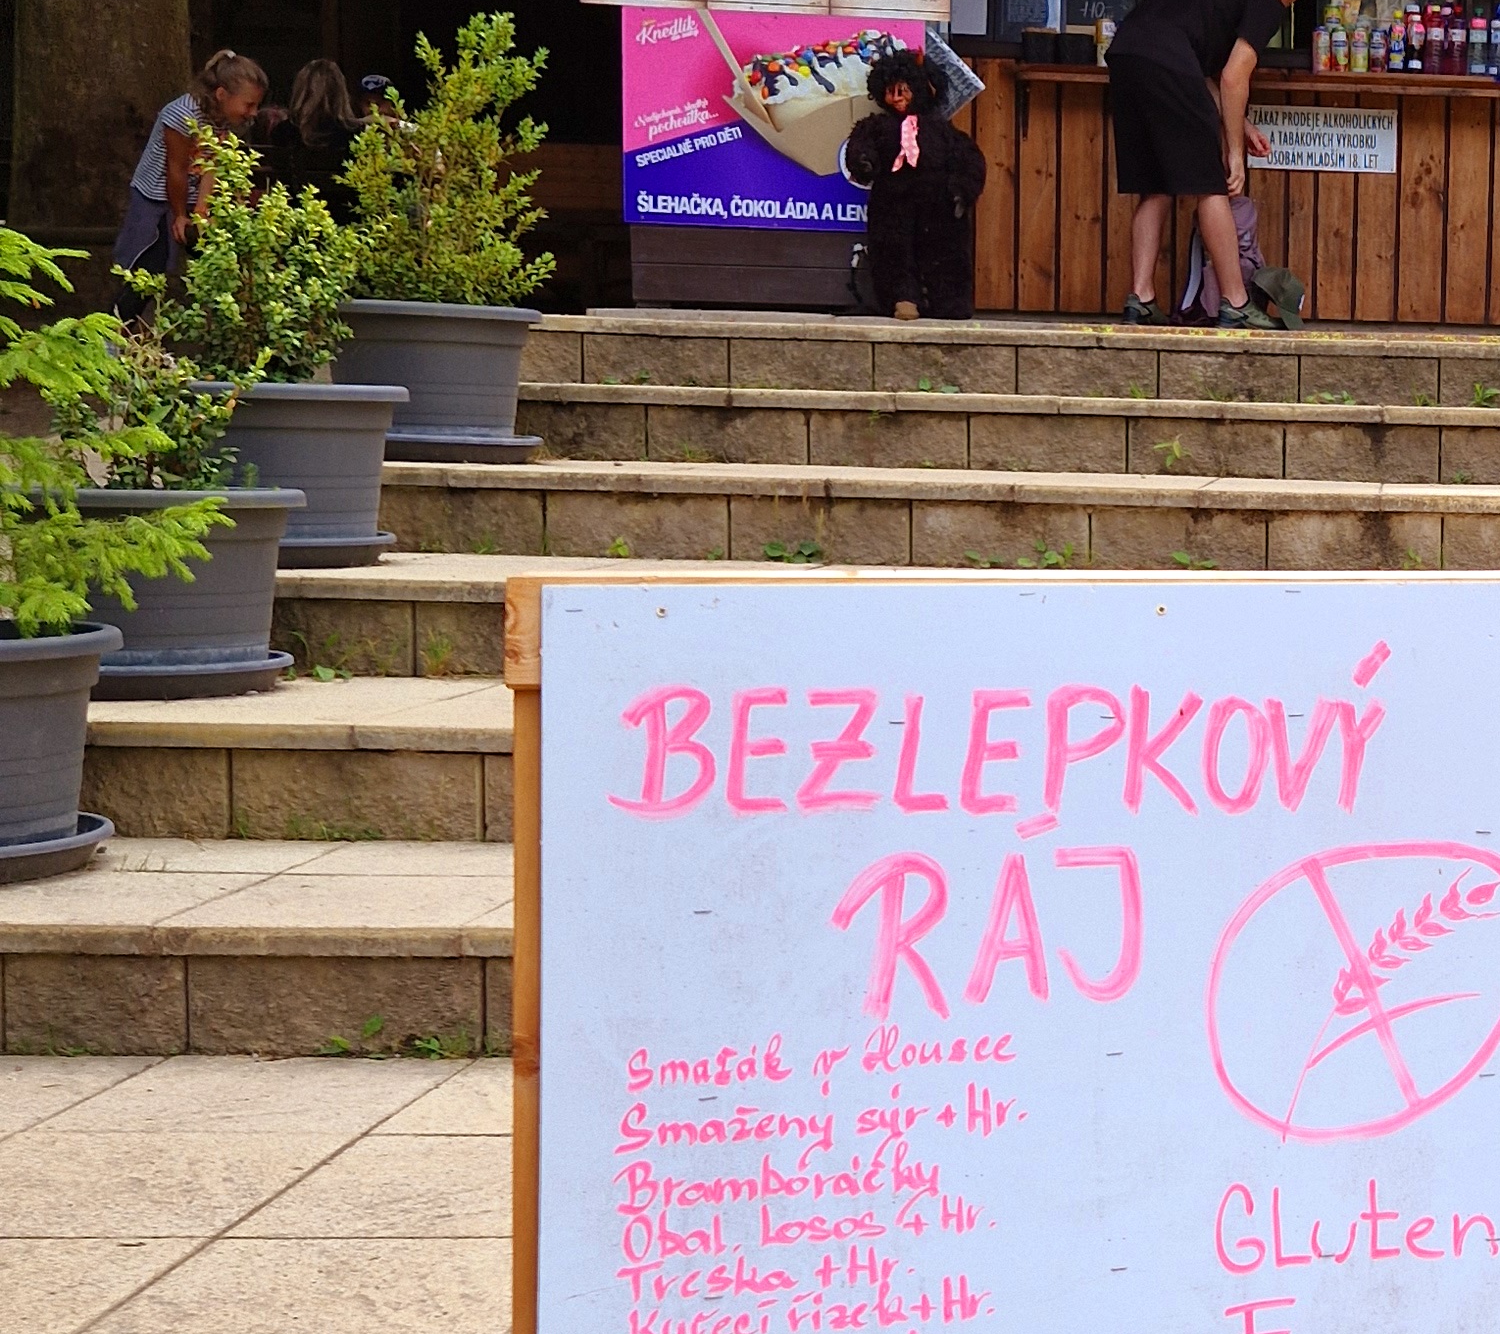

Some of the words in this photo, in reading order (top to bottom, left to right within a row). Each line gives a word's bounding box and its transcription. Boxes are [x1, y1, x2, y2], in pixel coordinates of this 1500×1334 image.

[1253, 108, 1279, 126] ZÁKAZ
[1282, 113, 1320, 131] PRODEJE
[1323, 111, 1394, 131] ALKOHOLICKÝCH
[694, 134, 717, 150] PRO
[717, 127, 742, 144] DĚTI
[1270, 134, 1275, 145] A
[1279, 128, 1333, 150] TABÁKOVÝCH
[1267, 149, 1303, 166] OSOBÁM
[1306, 151, 1345, 167] MLADŠÍM
[1363, 155, 1378, 169] LET
[637, 190, 728, 219] ŠLEHAČKA,
[730, 194, 819, 220] ČOKOLÁDA
[821, 203, 835, 220] A
[604, 637, 1395, 821] BEZLEPKOVÝ
[829, 810, 1146, 1021] RÁJ
[759, 1203, 887, 1247] Losos
